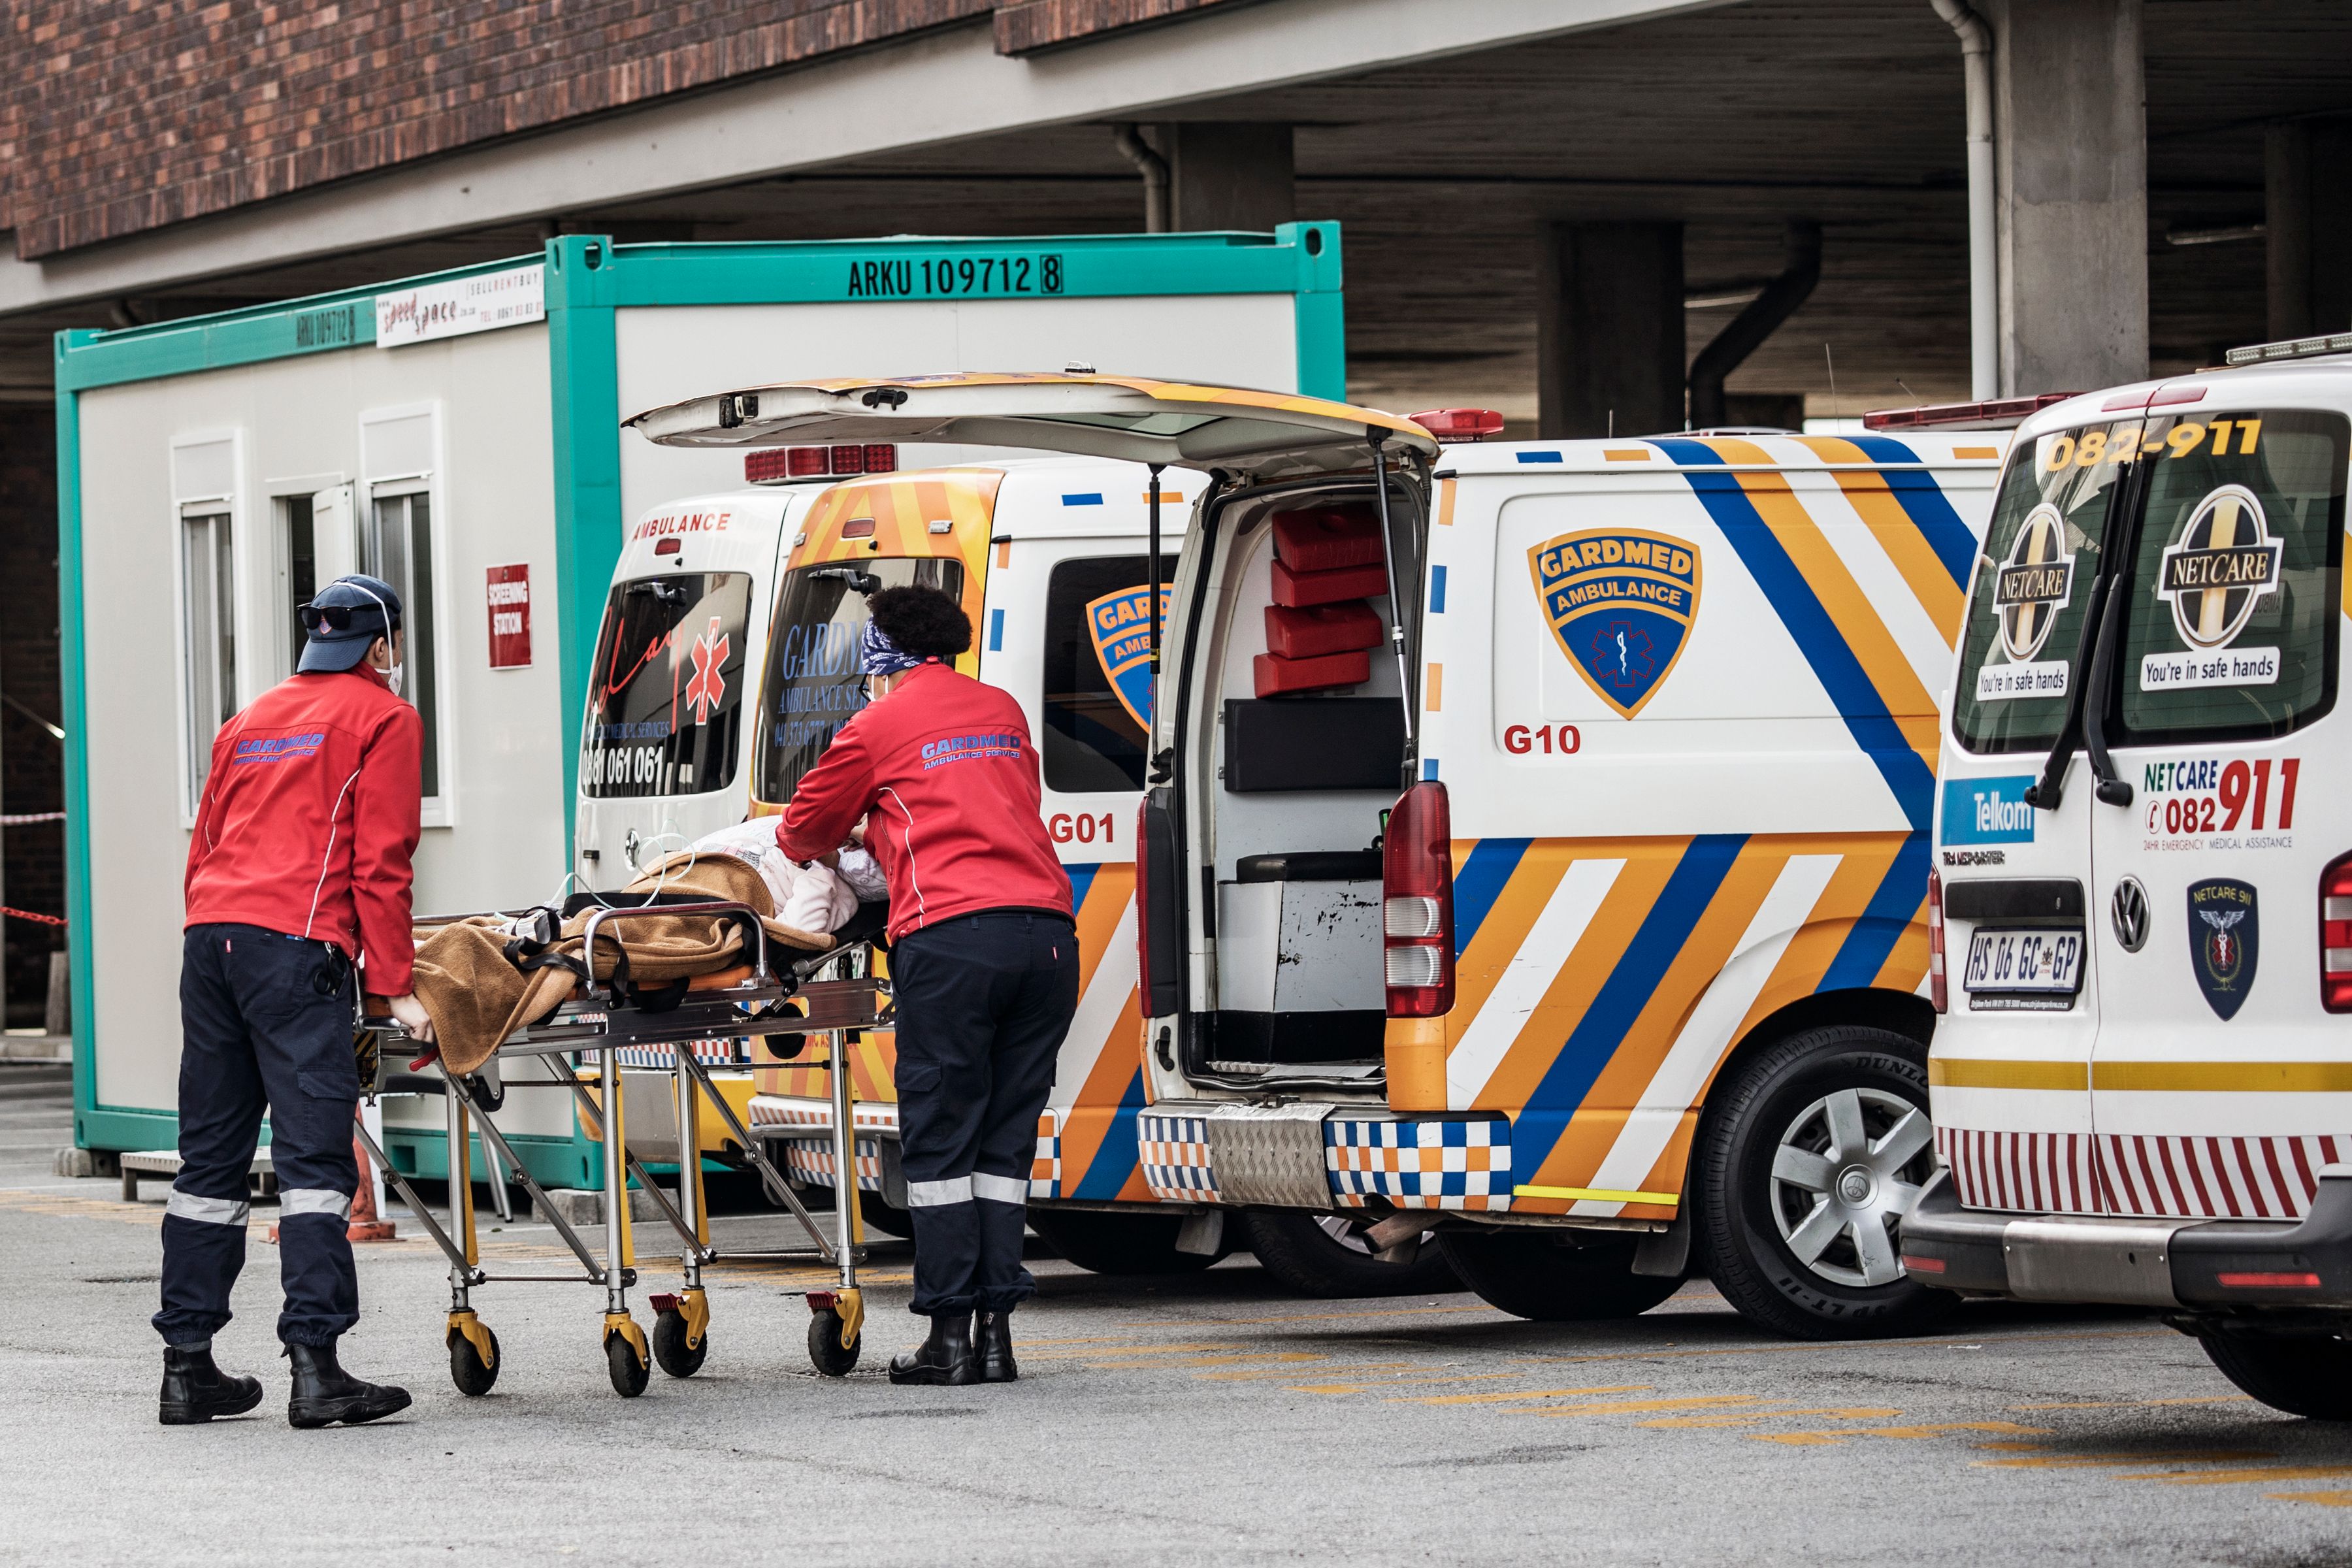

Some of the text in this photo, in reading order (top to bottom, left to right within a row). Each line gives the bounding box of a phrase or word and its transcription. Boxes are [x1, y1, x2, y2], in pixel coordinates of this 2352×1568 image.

[848, 255, 1061, 296] ARKU 109712 8
[2046, 419, 2262, 472] 082-911
[632, 513, 731, 542] AMBULANCE
[1540, 540, 1692, 578] GARDMED
[2172, 553, 2268, 585] NETCARE
[489, 581, 528, 606] SCREENING
[1556, 581, 1682, 612] AMBULANCE
[2001, 569, 2065, 600] NETCARE
[493, 612, 521, 636] STATION
[2005, 672, 2012, 691] in
[2015, 670, 2033, 690] safe
[2036, 669, 2064, 689] hands
[2186, 660, 2197, 680] in
[2202, 658, 2227, 679] safe
[2233, 655, 2273, 677] hands
[778, 685, 843, 713] AMBULANCE
[237, 732, 325, 755] GARDMED
[787, 721, 802, 746] 373
[804, 720, 825, 745] 6777
[921, 733, 1021, 760] GARDMED
[1504, 725, 1580, 754] G10
[608, 747, 632, 784] 061
[634, 746, 664, 784] 061
[924, 749, 1020, 771] AMBULANCE SERVICE
[2144, 758, 2300, 831] NETCARE 911
[1974, 791, 2031, 832] Telkom
[2166, 797, 2215, 834] 082
[1049, 813, 1113, 843] G01
[2144, 836, 2293, 851] 24HR EMERGENCY MEDICAL ASSISTANCE
[2193, 886, 2236, 904] NETCARE
[1970, 936, 2076, 980] HS 06 GC GP
